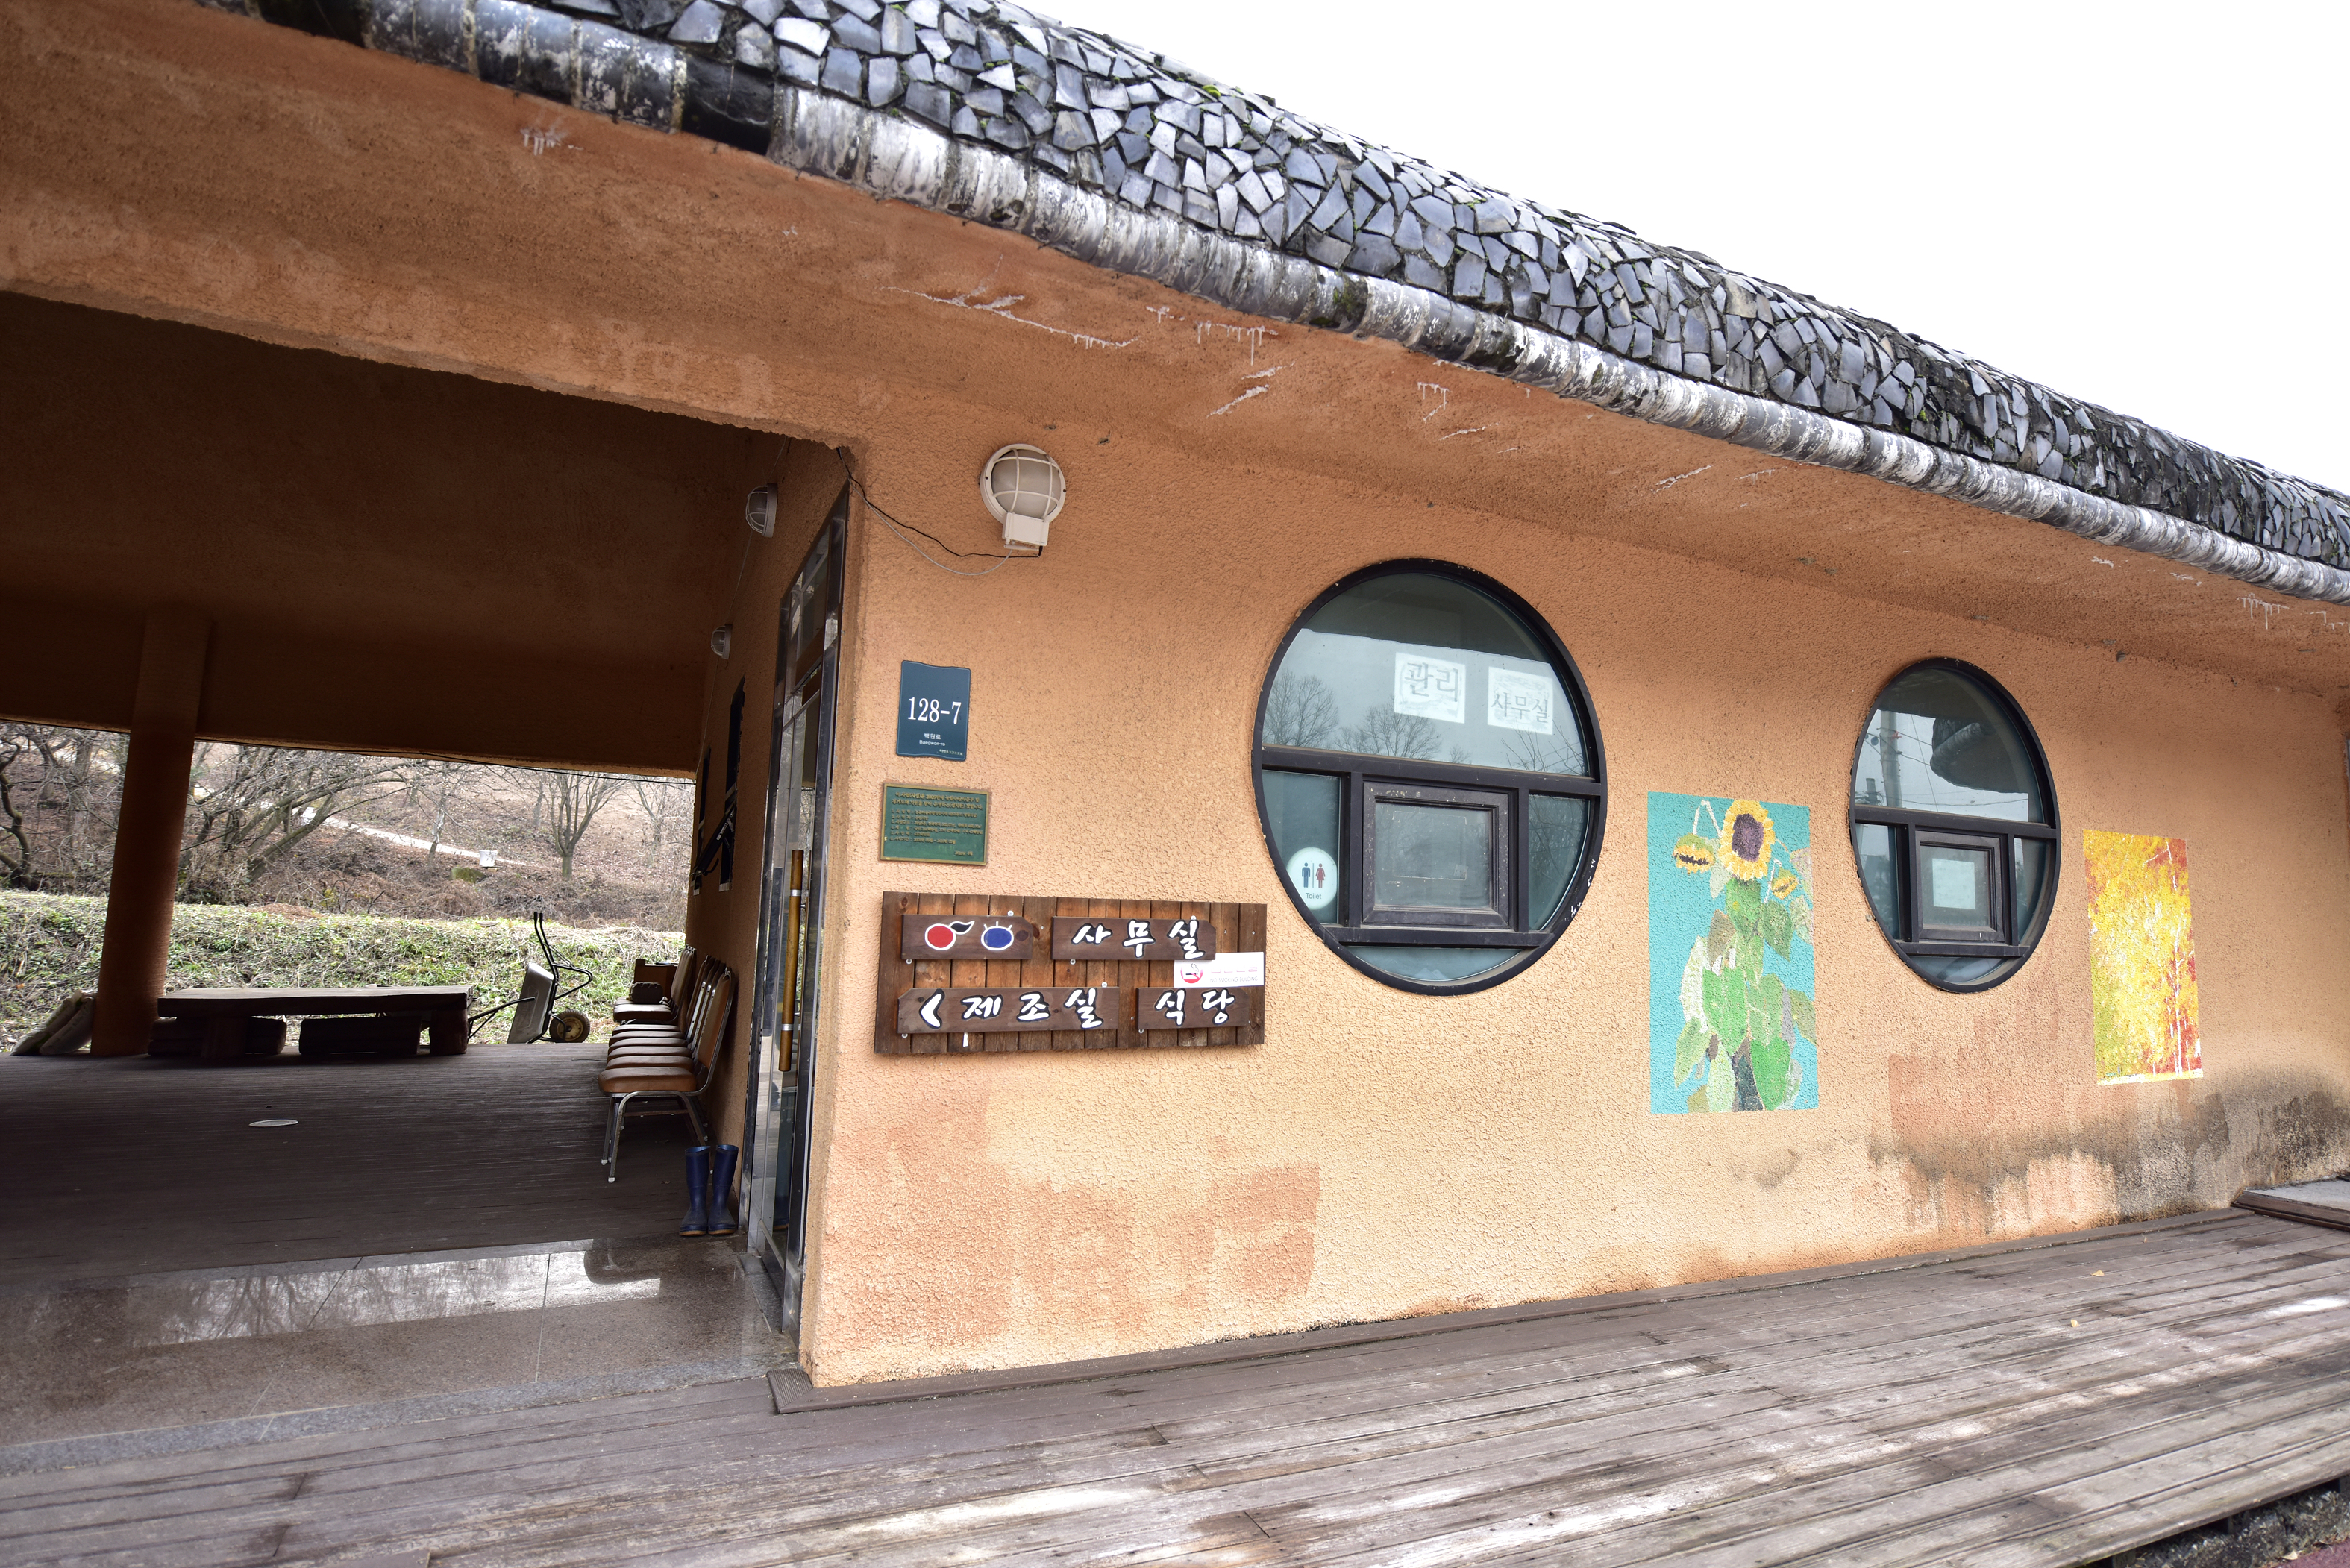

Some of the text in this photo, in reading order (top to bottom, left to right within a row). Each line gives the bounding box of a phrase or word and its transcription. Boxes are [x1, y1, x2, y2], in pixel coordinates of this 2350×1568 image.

[1404, 661, 1460, 703] 관리
[907, 697, 962, 724] 128-7
[1491, 691, 1550, 724] 사무실
[1071, 918, 1205, 959] 사무실
[961, 988, 1103, 1029] 제조실
[1154, 988, 1235, 1026] 식당
